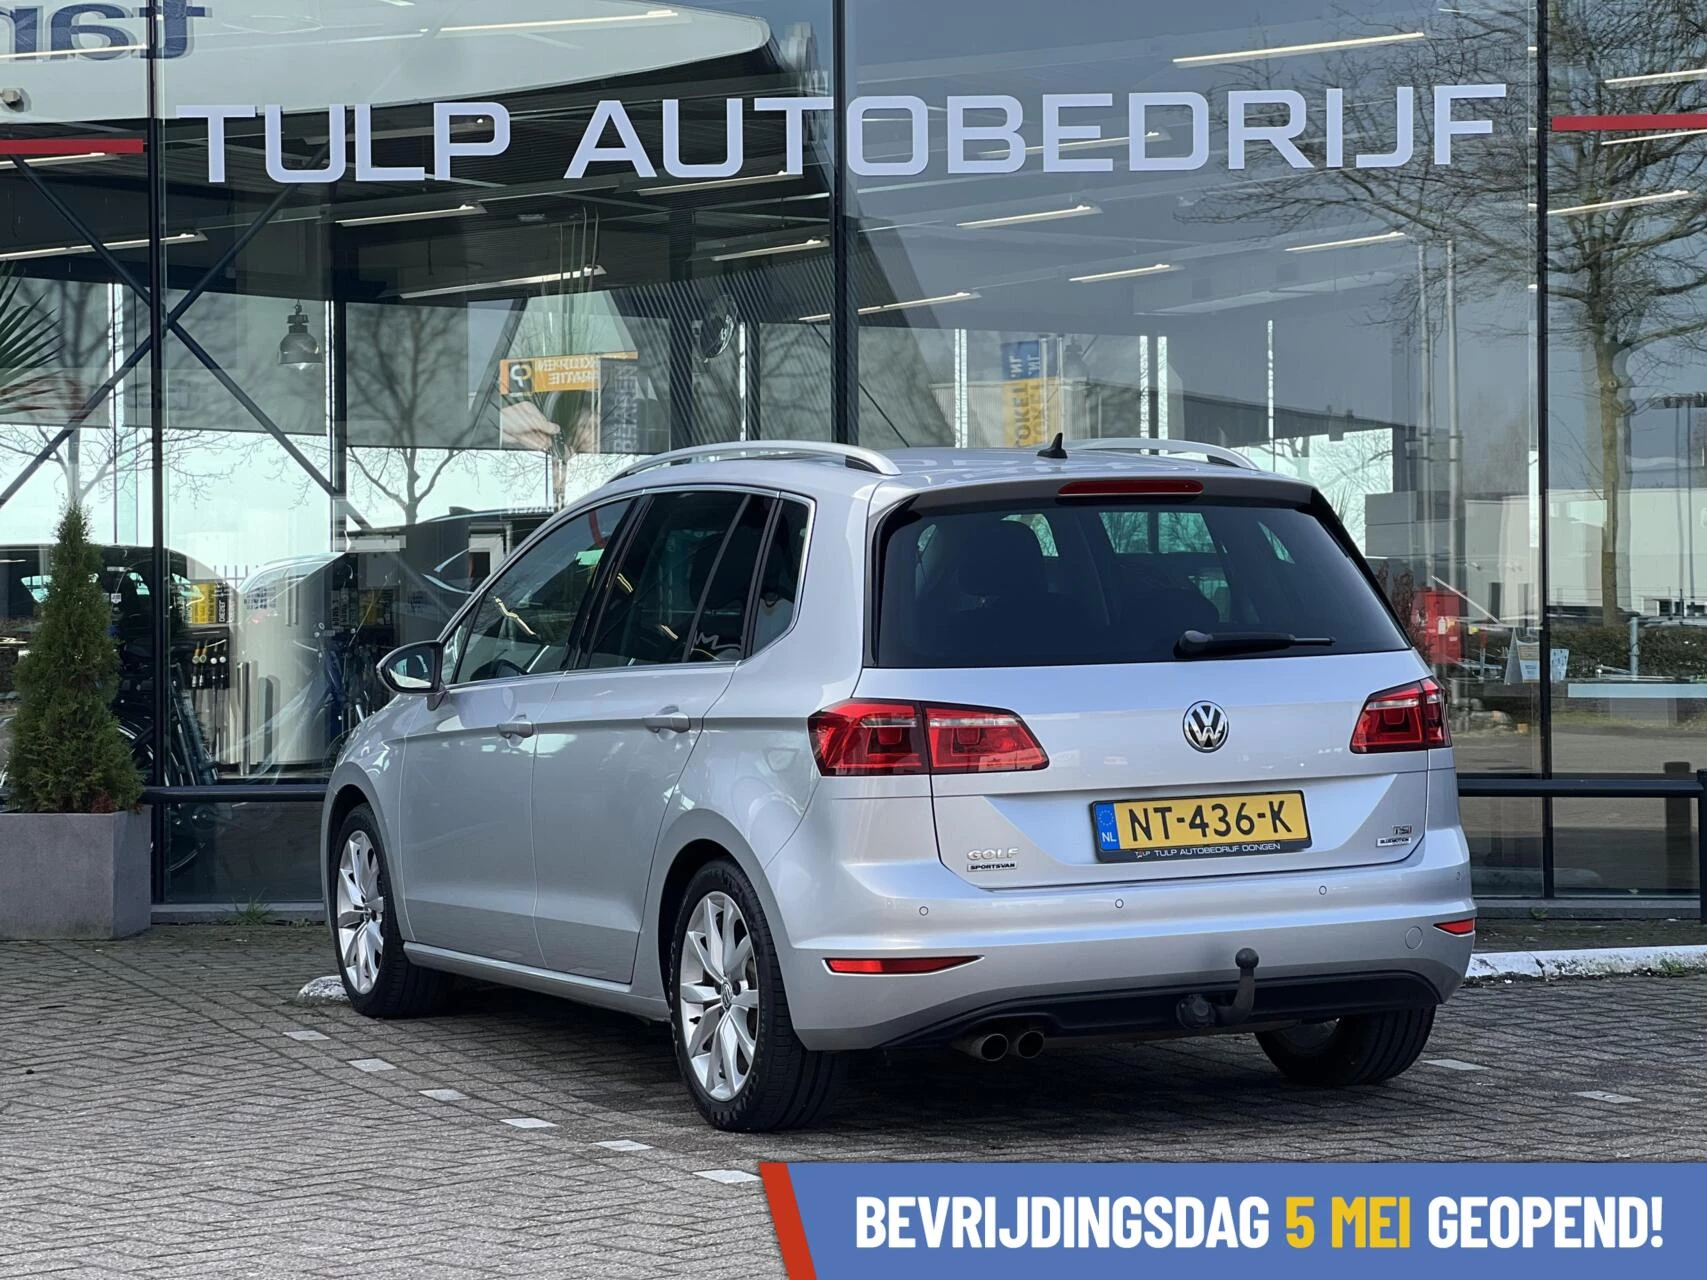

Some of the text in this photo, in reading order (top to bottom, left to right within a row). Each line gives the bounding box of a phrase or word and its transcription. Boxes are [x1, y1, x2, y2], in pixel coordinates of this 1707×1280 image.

[175, 84, 1507, 184] TULP AUTOBEDRIJF
[1128, 800, 1293, 842] NT-436-K
[1101, 831, 1117, 842] NL
[966, 847, 1019, 861] GOLF
[1154, 848, 1178, 857] TULP
[1180, 845, 1240, 856] AUTOBEDRIJF
[1242, 842, 1280, 852] DONGEN
[970, 862, 1016, 870] SPORTSVAN
